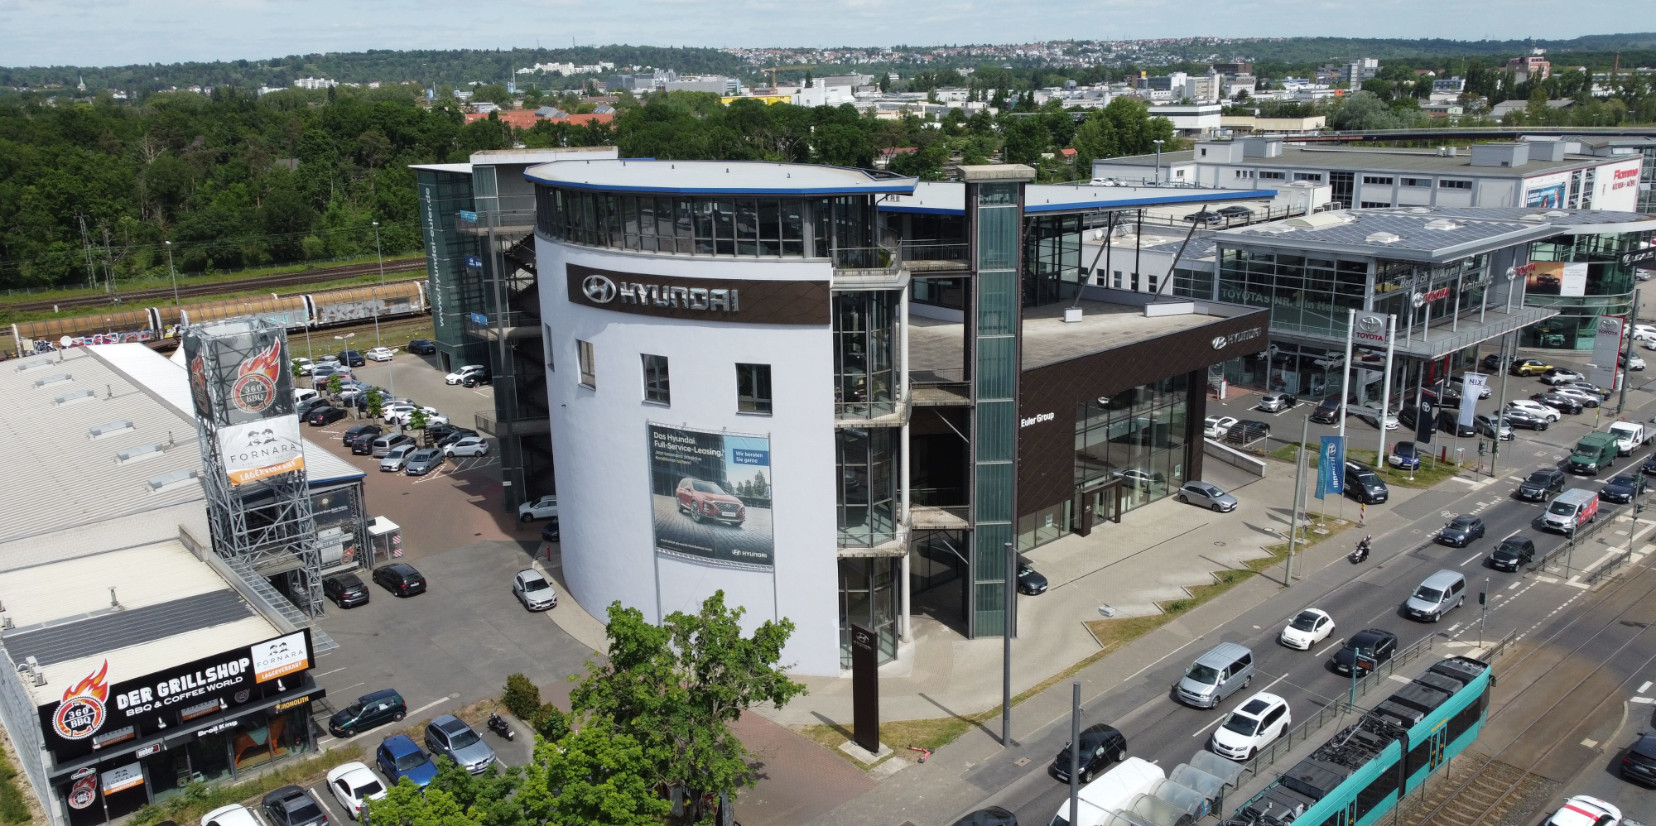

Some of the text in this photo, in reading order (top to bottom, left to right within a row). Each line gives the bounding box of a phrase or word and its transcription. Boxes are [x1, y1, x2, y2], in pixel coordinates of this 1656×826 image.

[425, 188, 444, 327] www.hyundai-euler.de
[620, 281, 739, 312] HYUNDAI
[1425, 287, 1449, 303] TOYOTA
[1317, 301, 1350, 314] Hesse
[1356, 332, 1383, 341] TOYOTA
[1021, 412, 1054, 427] Euler Group
[653, 431, 696, 445] Das Hyundai
[230, 443, 297, 463] FORNARA
[742, 551, 768, 559] HYUNDAI
[257, 649, 304, 668] FORNARA
[261, 661, 303, 680] LAGERVERKAUF
[116, 657, 250, 710] DER GRILLSHOP
[126, 704, 152, 717] BBQ
[163, 688, 206, 706] COFFEE
[206, 676, 244, 691] WORLD
[70, 717, 91, 729] BBQ
[198, 720, 239, 736] Broil King
